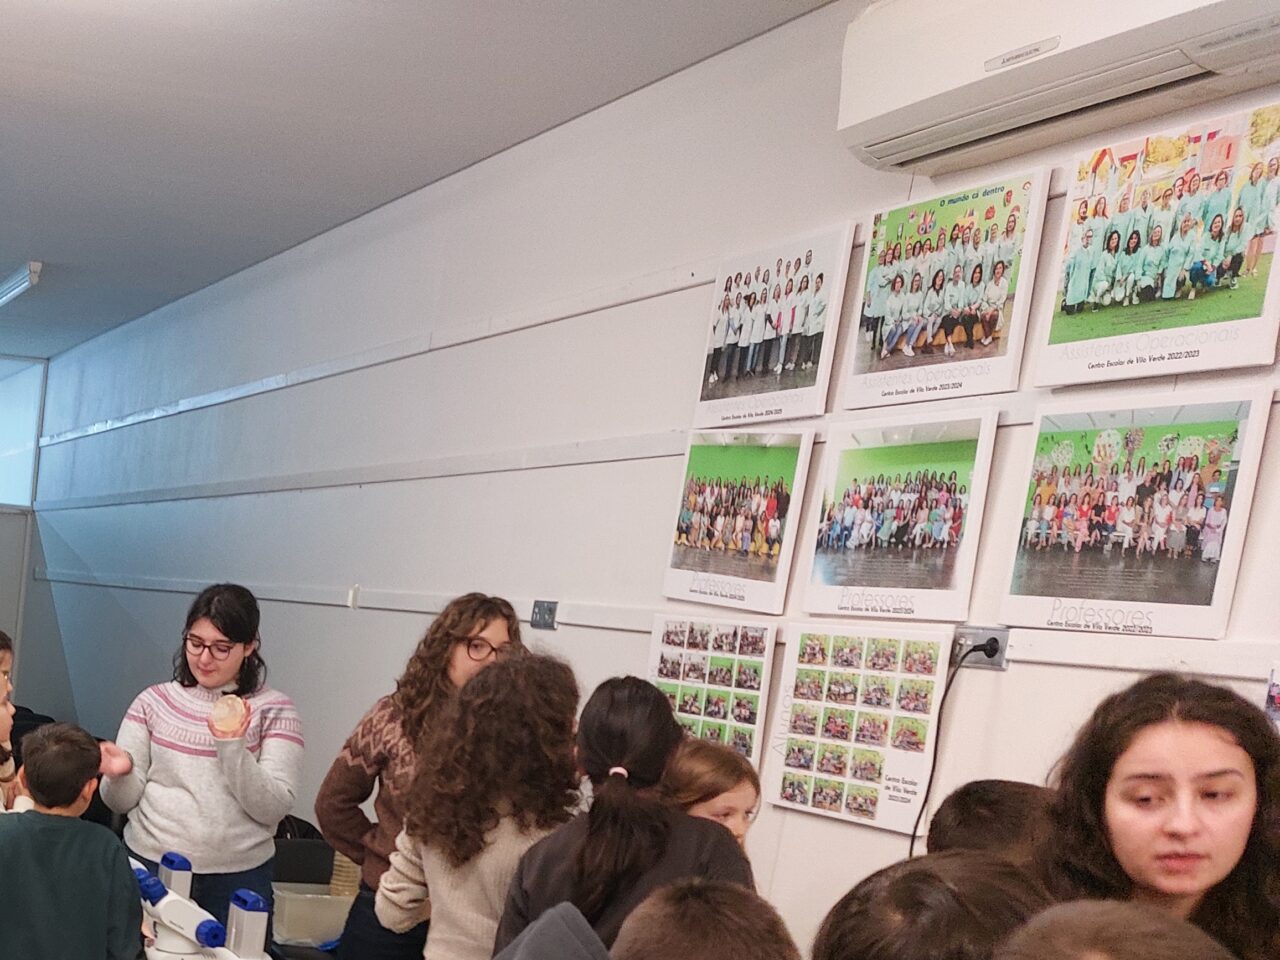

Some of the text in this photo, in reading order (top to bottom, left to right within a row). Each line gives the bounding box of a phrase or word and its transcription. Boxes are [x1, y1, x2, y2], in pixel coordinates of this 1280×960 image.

[982, 186, 1005, 197] dentro
[1136, 327, 1240, 351] Operacionais
[1087, 361, 1105, 370] Centro
[1106, 359, 1125, 368] Escolar
[1148, 354, 1166, 363] Verde
[1051, 598, 1153, 625] Professores
